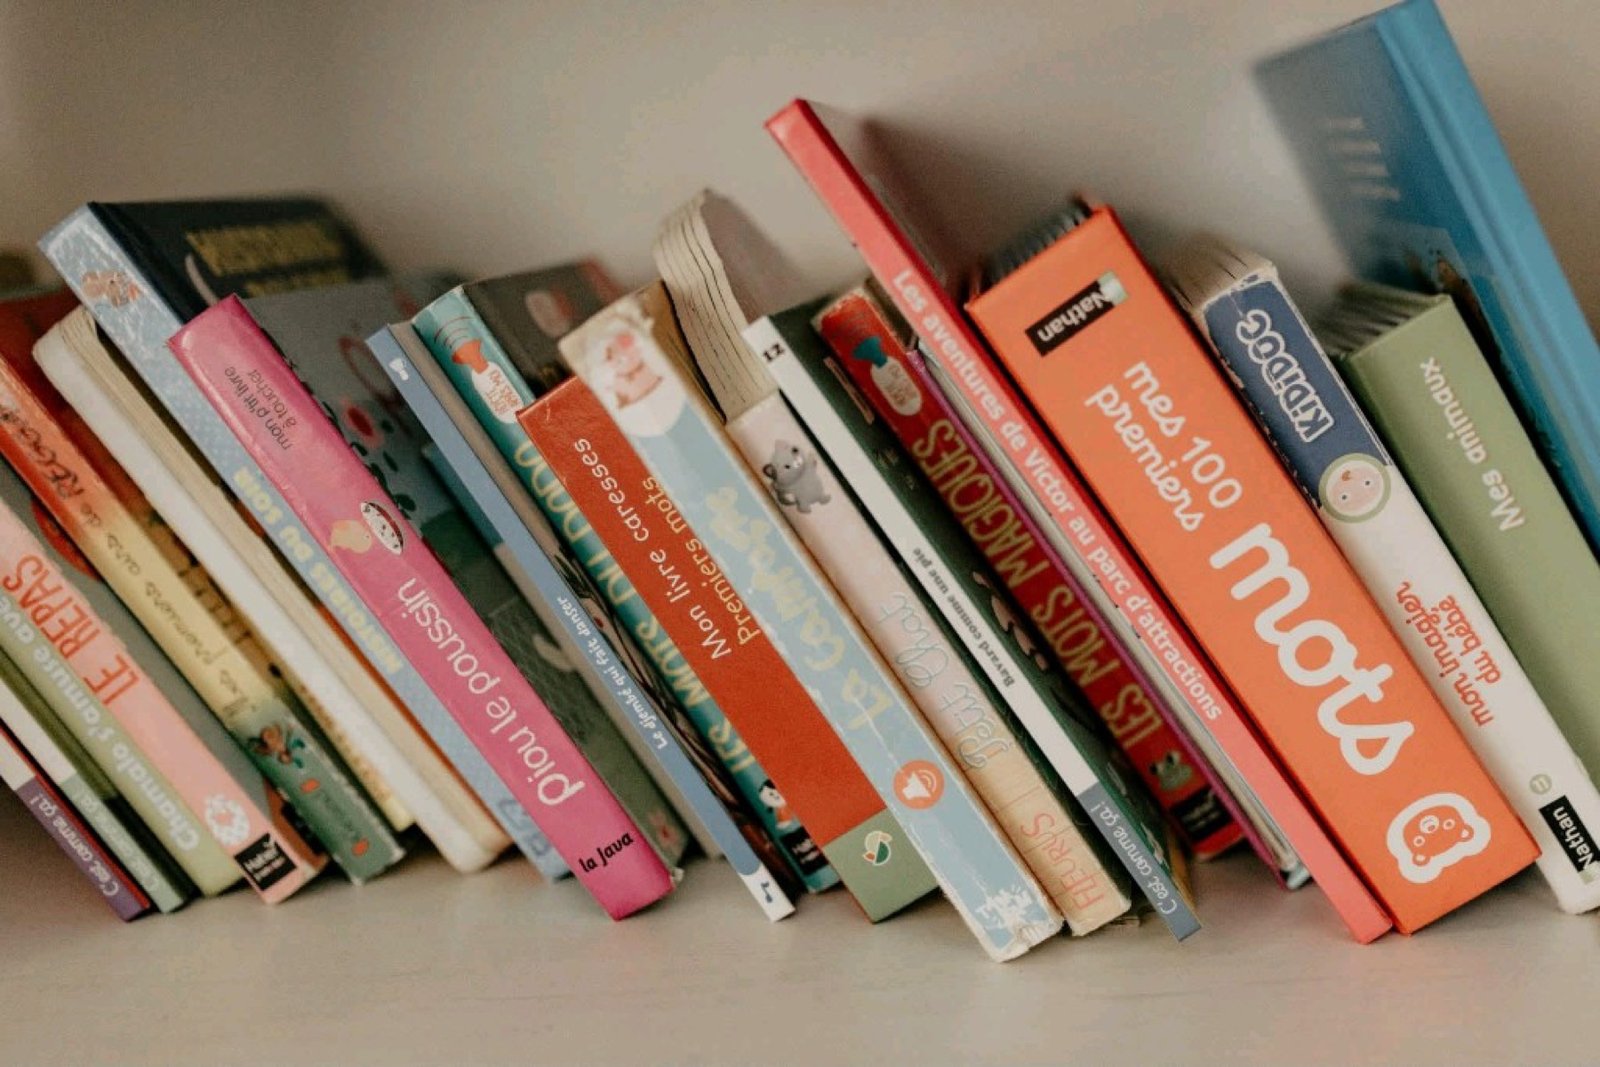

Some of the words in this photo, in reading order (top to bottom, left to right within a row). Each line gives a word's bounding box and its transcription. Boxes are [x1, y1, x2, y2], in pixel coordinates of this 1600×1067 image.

[1033, 286, 1112, 344] Nathan
[224, 366, 250, 398] livre
[247, 367, 289, 420] toucher
[264, 417, 292, 451] mon
[282, 416, 298, 429] à
[1124, 361, 1186, 438] mes
[1179, 436, 1244, 510] 100
[1419, 356, 1487, 465] animaux
[1084, 384, 1206, 532] premiers
[573, 438, 650, 542] caresses
[642, 472, 690, 534] mots
[893, 269, 928, 311] Les
[922, 314, 1005, 421] aventures
[1000, 421, 1027, 451] de
[1024, 447, 1075, 513] Victor
[1068, 516, 1095, 546] au
[1086, 546, 1131, 595] parc
[1125, 595, 1222, 721] d'attractions
[912, 418, 1050, 587] MAGIQUES
[1481, 468, 1525, 531] Mes
[277, 523, 316, 565] DU
[913, 548, 933, 569] pie
[649, 549, 691, 603] livre
[685, 534, 765, 645] Premiers
[928, 569, 949, 594] une
[1, 555, 100, 661] REPAS
[397, 577, 500, 695] poussin
[556, 596, 591, 637] danser
[689, 604, 732, 660] Mon
[947, 595, 982, 640] comme
[1031, 584, 1127, 686] MOTS
[1396, 581, 1460, 679] imagier
[1430, 595, 1482, 657] bébé
[588, 637, 609, 665] fait
[877, 591, 949, 688] Chat
[977, 640, 1016, 688] Bavard
[1209, 522, 1415, 776] mots
[1474, 650, 1502, 684] du
[33, 646, 115, 742] s'amuse
[82, 654, 139, 707] LE
[605, 665, 626, 687] qui
[840, 668, 894, 730] La
[1453, 672, 1493, 727] mon
[485, 696, 517, 734] le
[618, 687, 657, 729] djembé
[940, 682, 1011, 769] Petit
[1101, 683, 1163, 748] LES
[652, 731, 668, 750] Le
[112, 742, 201, 851] Chamalo
[52, 815, 94, 862] comme
[578, 857, 598, 873] la
[596, 832, 635, 867] Java
[1017, 809, 1107, 914] FLEURUS
[1113, 826, 1153, 876] comme
[1548, 805, 1599, 872] Nathan
[89, 860, 120, 896] C'est
[1146, 875, 1178, 915] C'est
